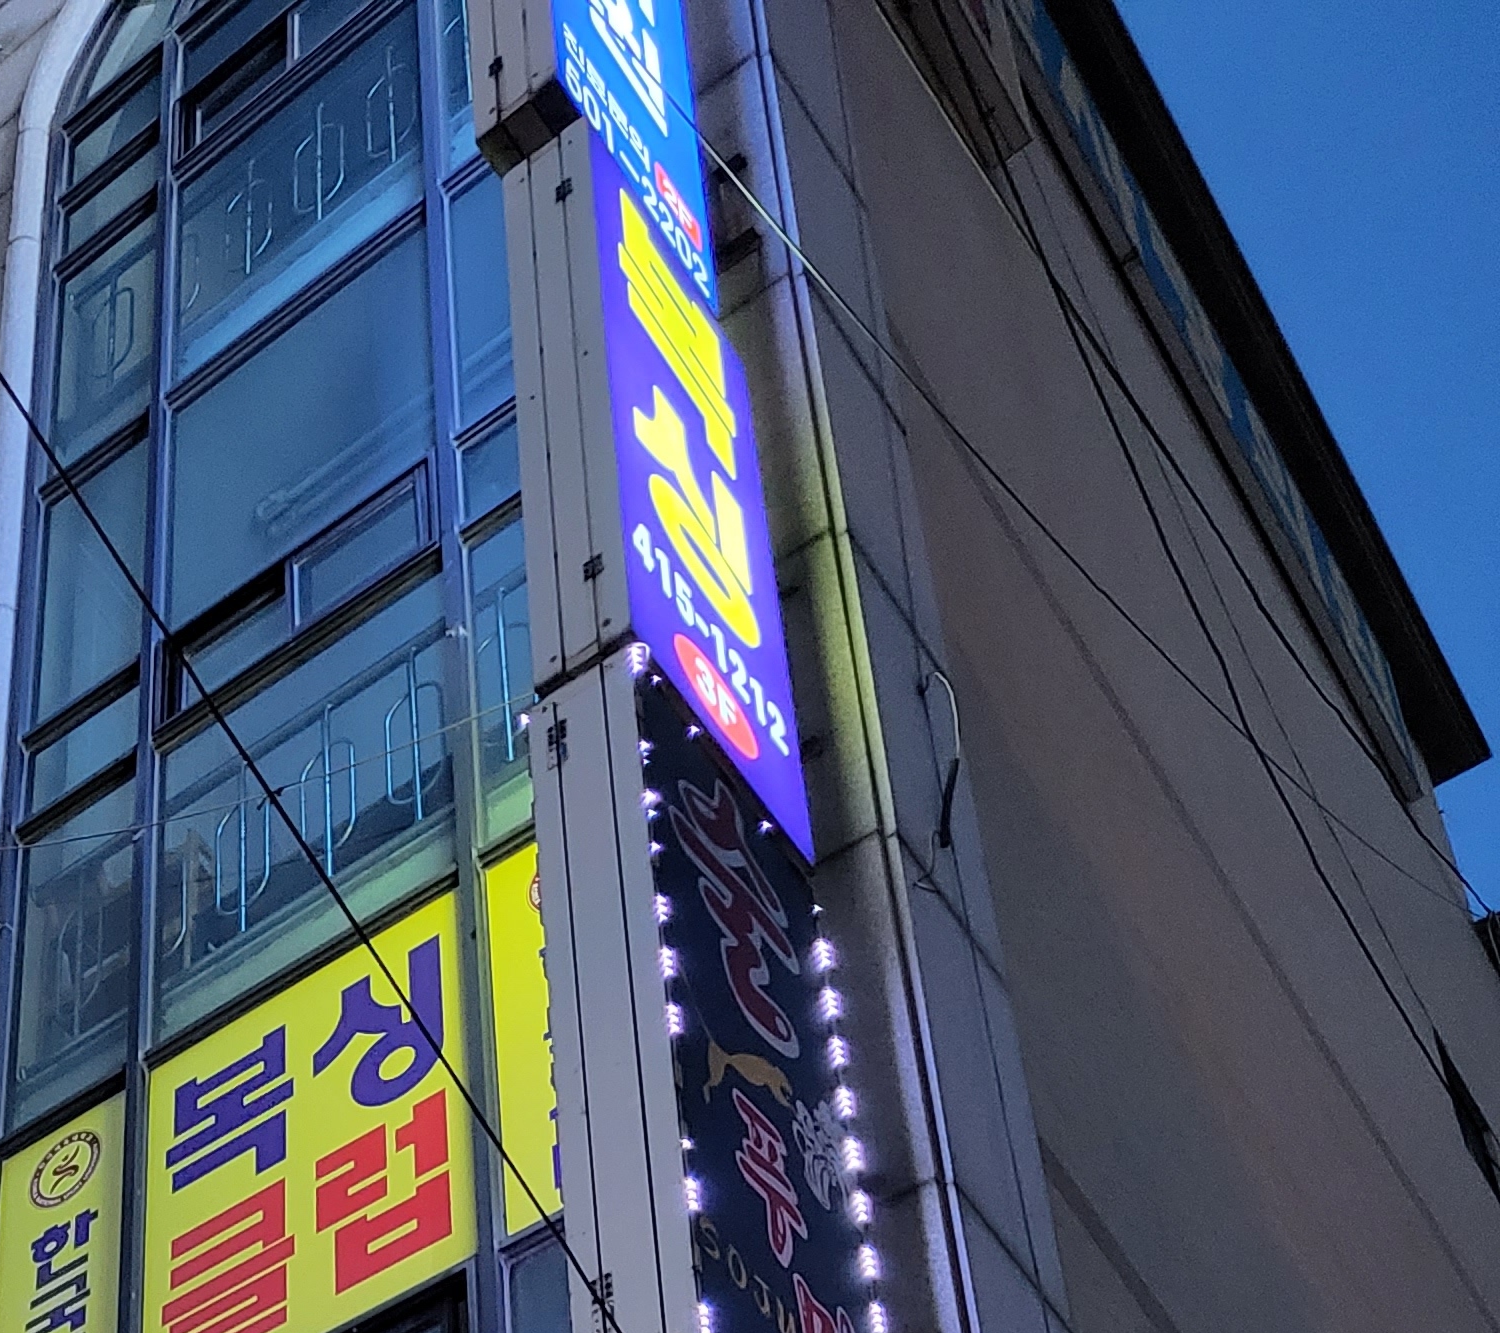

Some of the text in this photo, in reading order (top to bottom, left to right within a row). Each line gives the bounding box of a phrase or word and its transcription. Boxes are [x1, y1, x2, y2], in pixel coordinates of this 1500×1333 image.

[563, 22, 651, 173] 진료문의
[565, 58, 711, 299] 501-2202
[662, 179, 694, 230] 2F
[618, 188, 762, 650] 복싱
[631, 523, 791, 758] 415-1212
[694, 655, 738, 726] 3F
[164, 933, 445, 1195] 복싱
